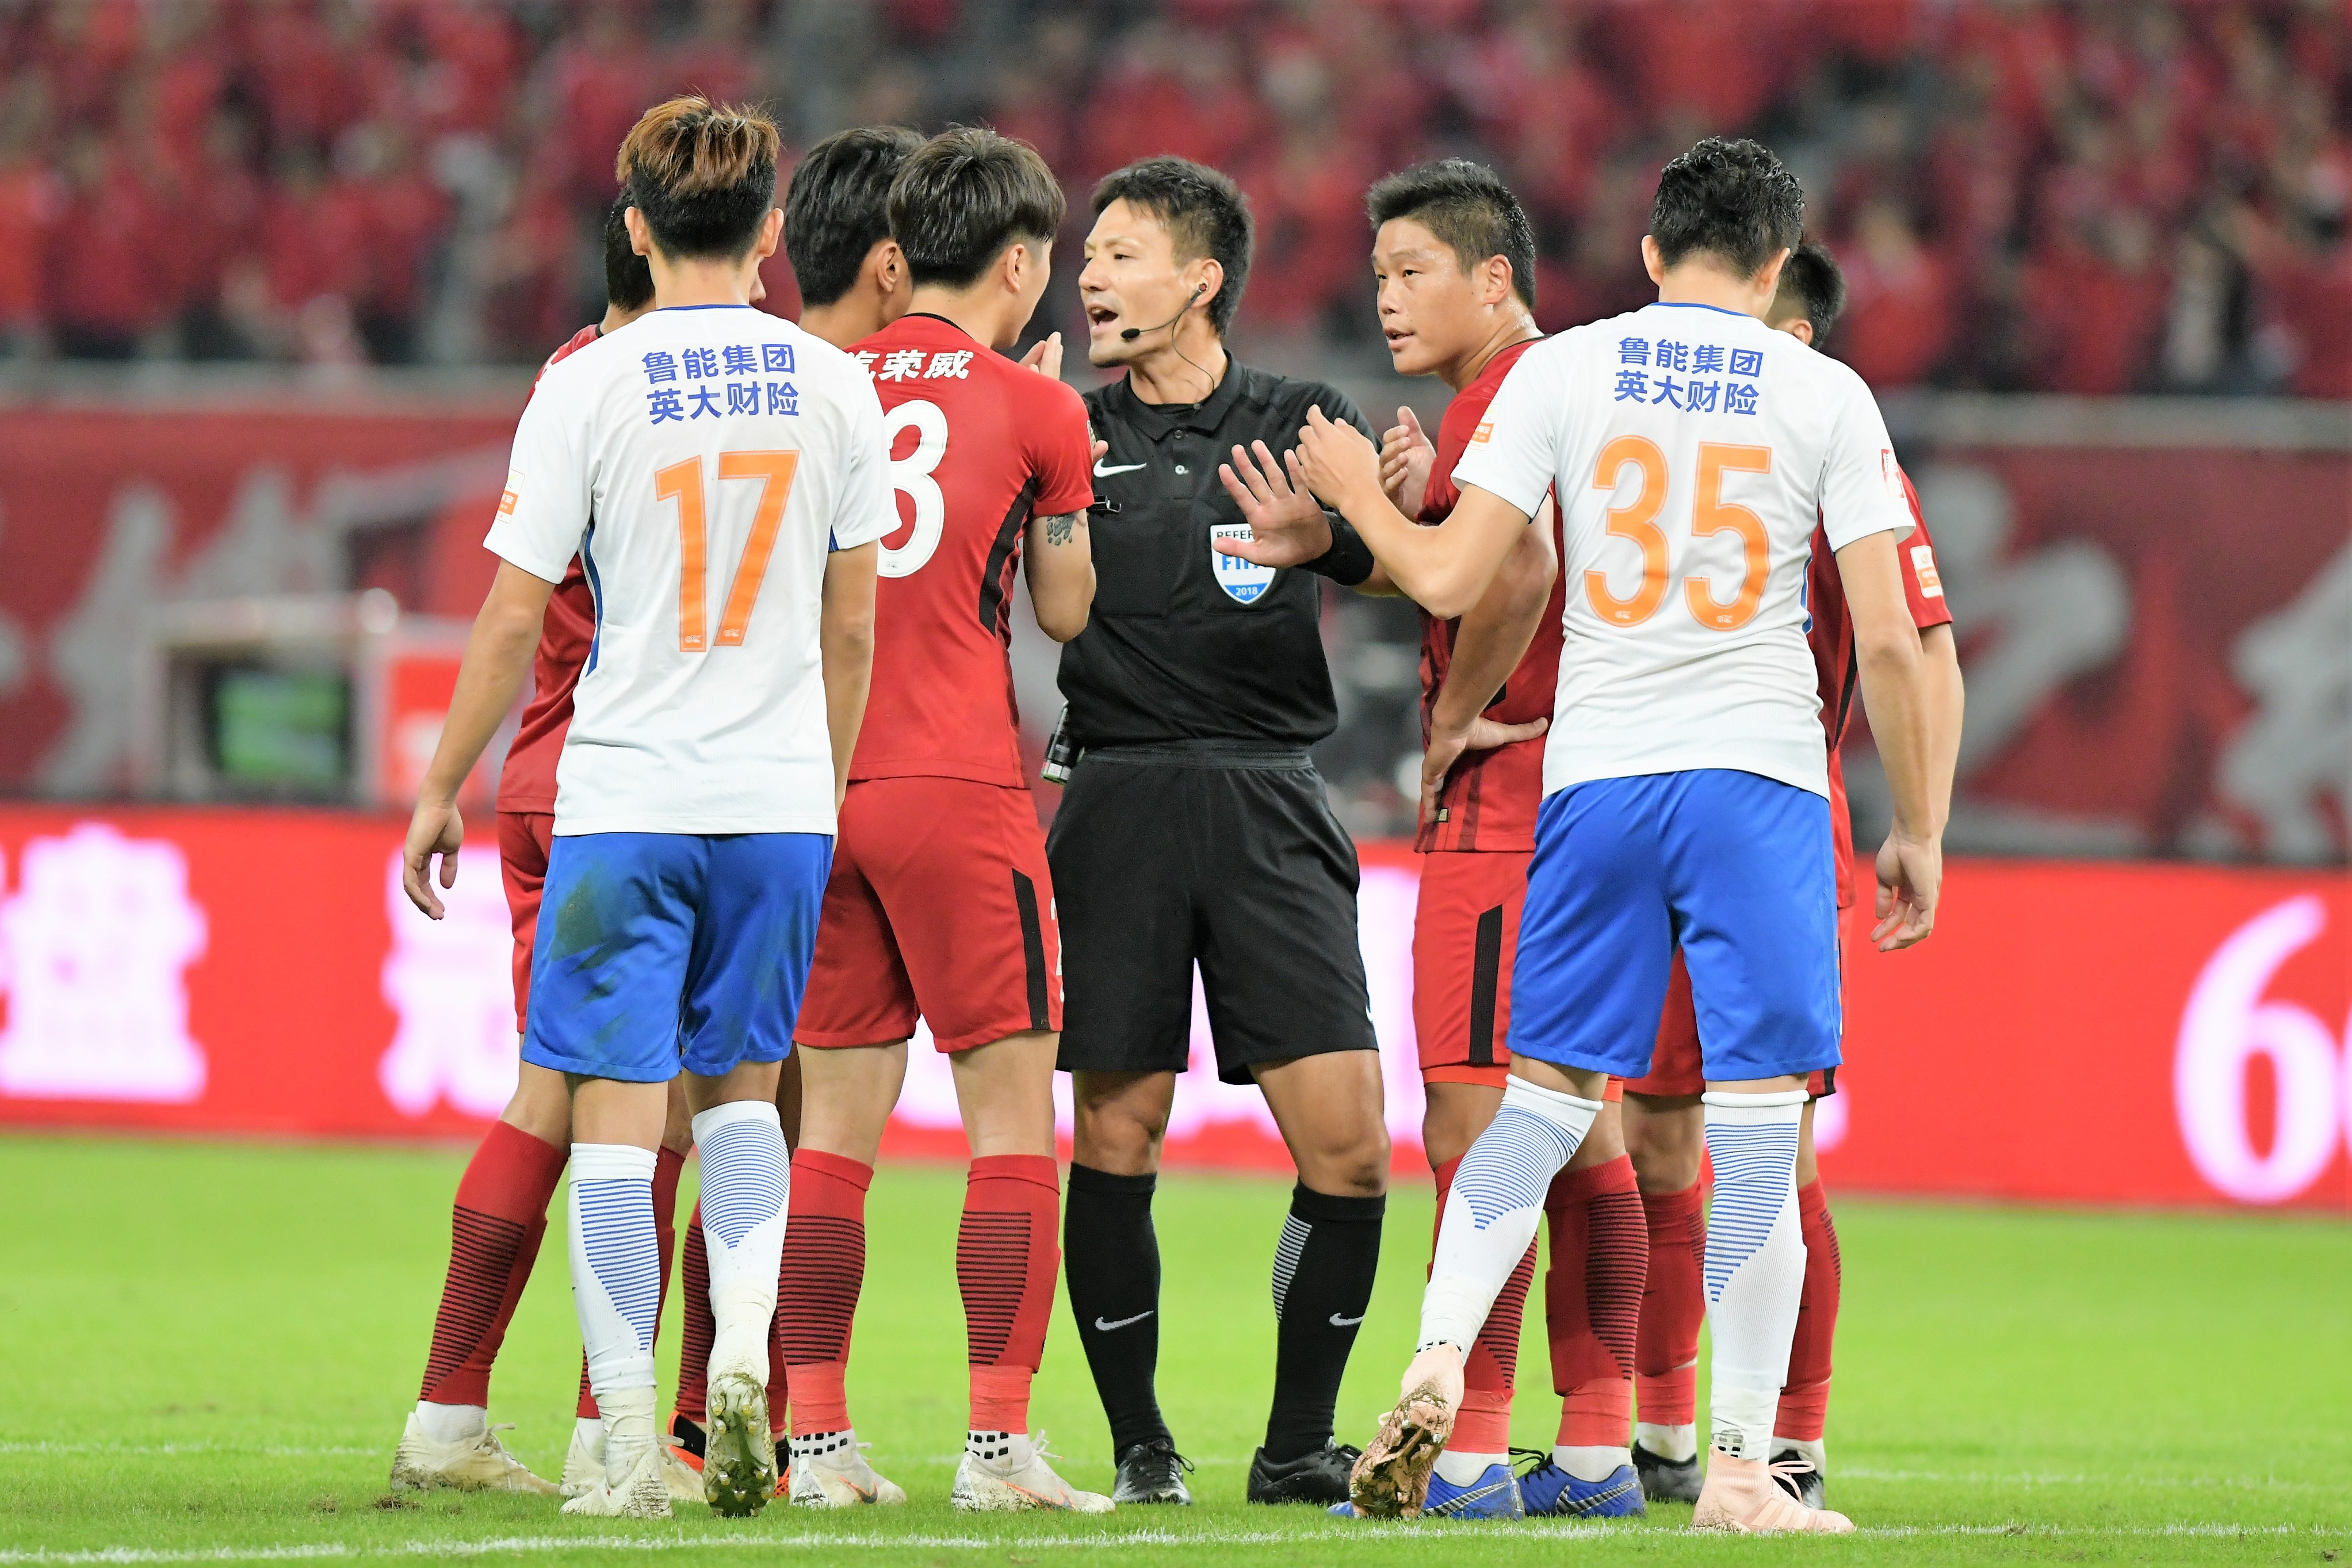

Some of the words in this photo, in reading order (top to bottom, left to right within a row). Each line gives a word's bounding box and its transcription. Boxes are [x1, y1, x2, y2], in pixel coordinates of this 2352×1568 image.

[641, 344, 796, 384] 鲁能集团
[1617, 337, 1764, 377] 鲁能集团
[647, 380, 800, 425] 英大财险
[1614, 369, 1760, 415] 英大财险
[654, 449, 800, 652] 17
[1217, 530, 1253, 540] REFER
[1583, 434, 1772, 632] 35
[1235, 586, 1259, 596] 2018
[2173, 894, 2352, 1203] 6
